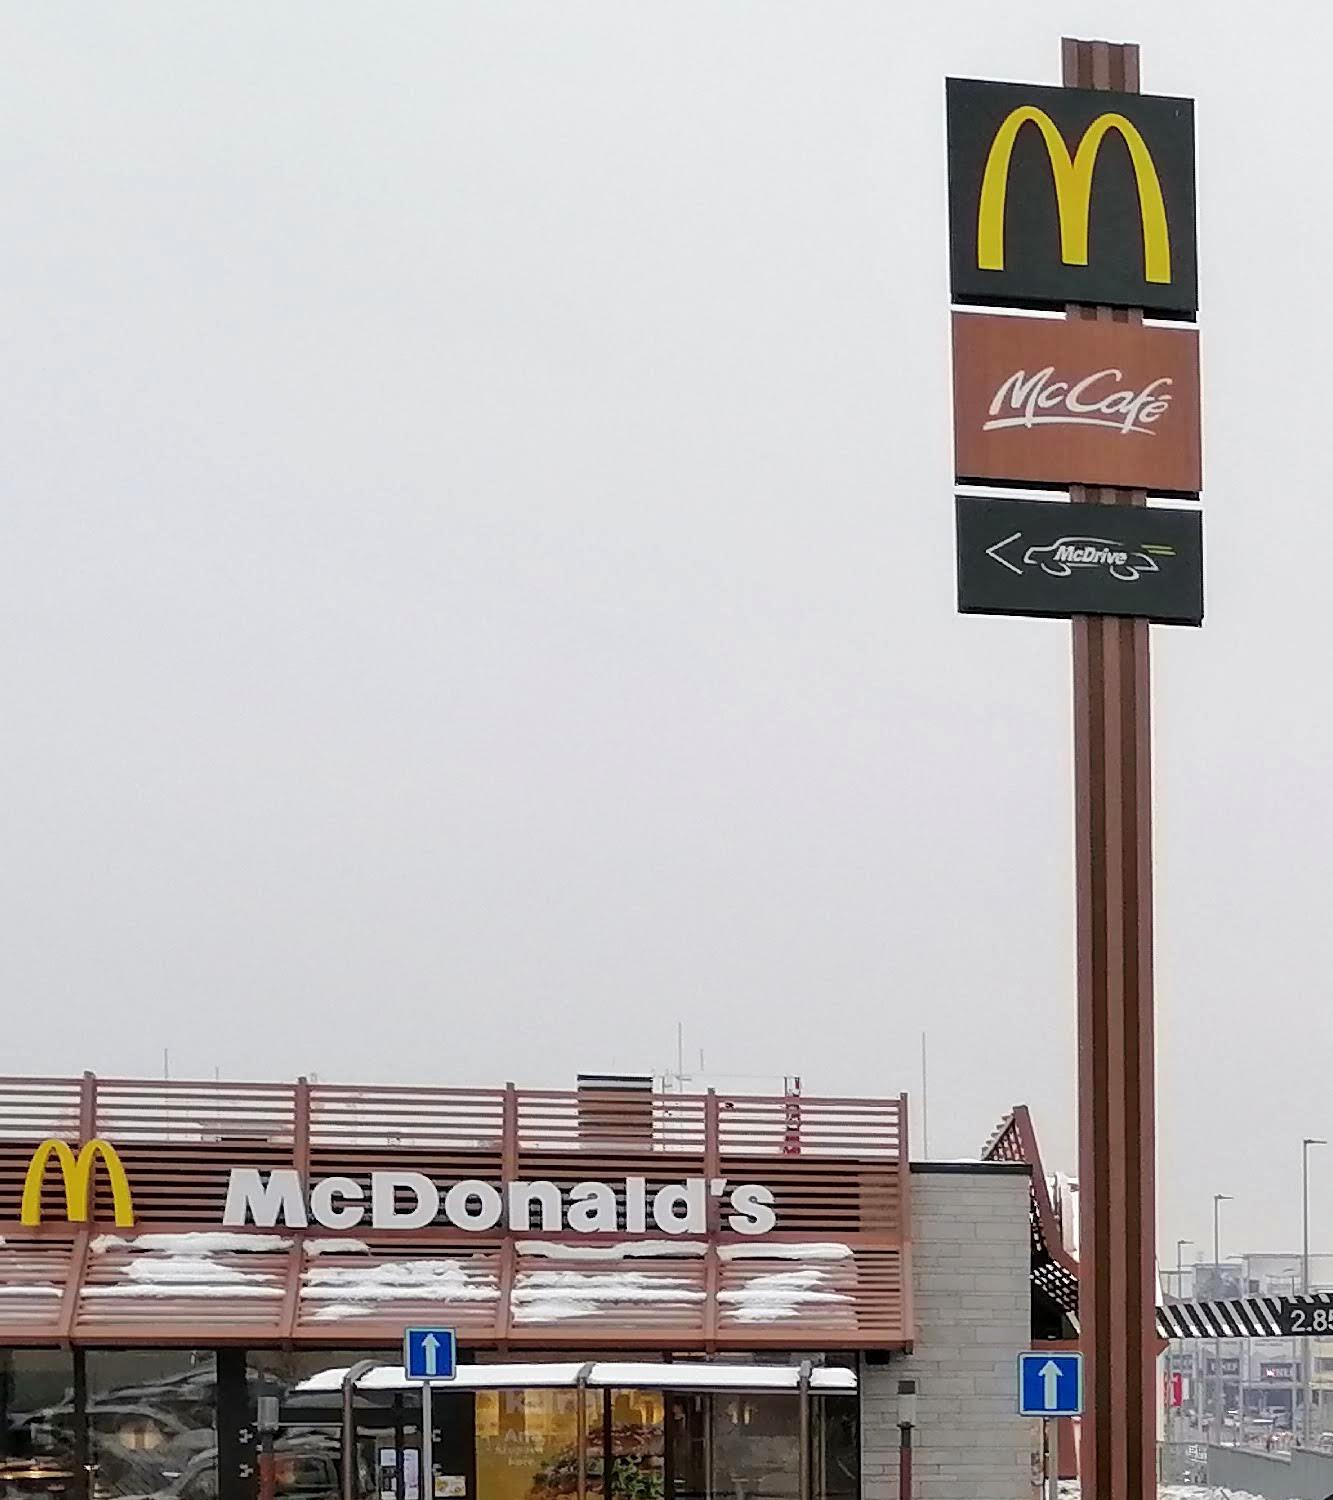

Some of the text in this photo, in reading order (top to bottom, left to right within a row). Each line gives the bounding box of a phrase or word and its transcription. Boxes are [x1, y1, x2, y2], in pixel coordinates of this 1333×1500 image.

[984, 366, 1173, 437] McCafé
[1054, 541, 1128, 567] McDrive
[222, 1166, 778, 1237] McDonald's
